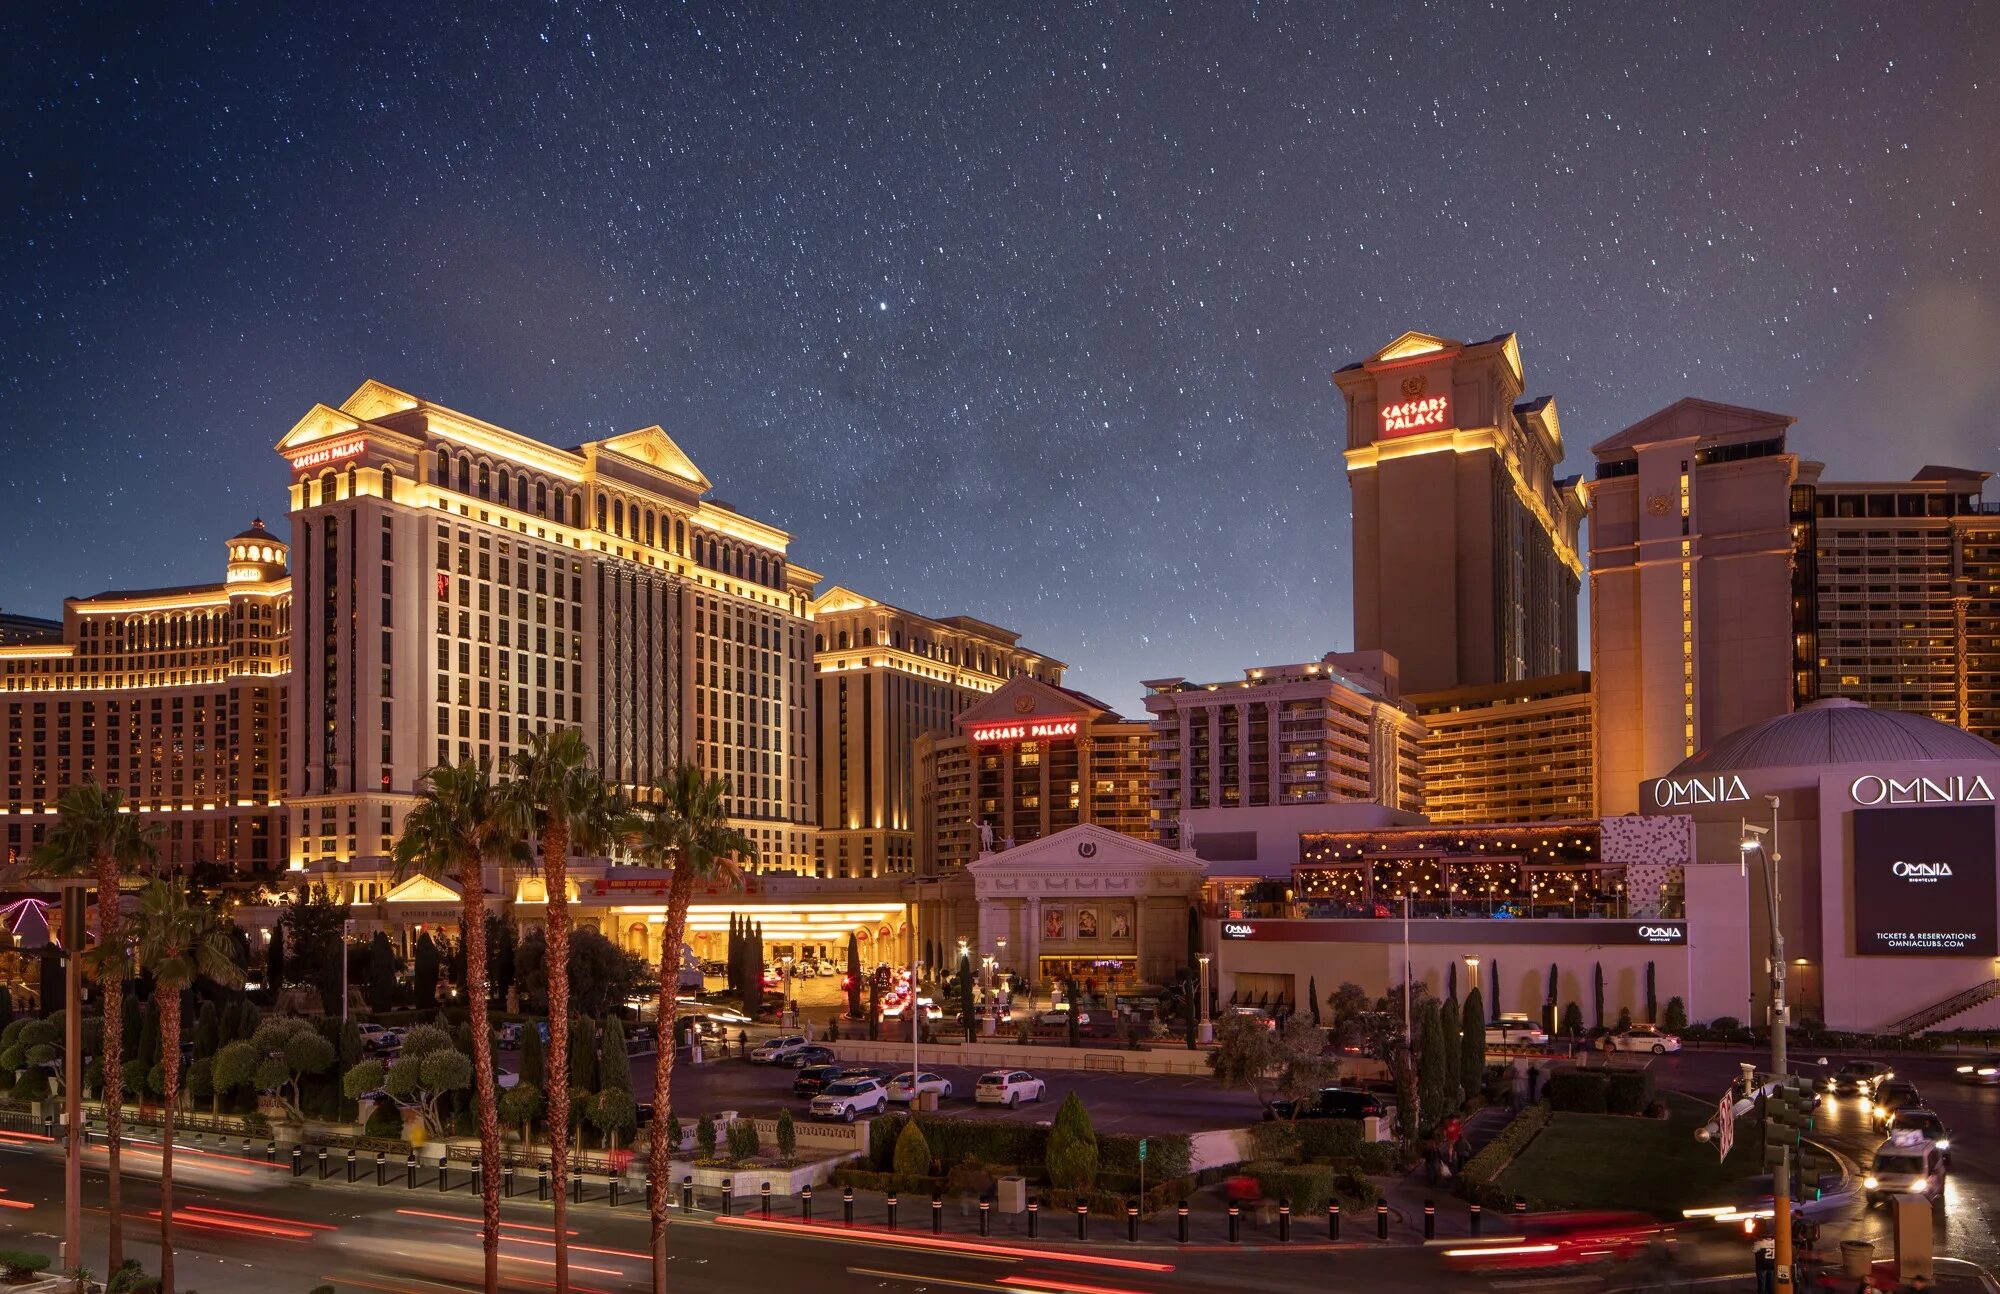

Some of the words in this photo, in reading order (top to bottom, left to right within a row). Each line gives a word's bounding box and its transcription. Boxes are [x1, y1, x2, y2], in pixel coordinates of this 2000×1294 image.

[1381, 396, 1448, 419] CAESARS
[1385, 409, 1444, 431] PALACE
[293, 449, 330, 469] CAESARS
[332, 440, 364, 459] PALACE
[973, 726, 1025, 741] CAESARS
[1031, 722, 1077, 736] PALACE
[1654, 775, 1751, 808] OMNIA
[1851, 775, 1996, 805] OMNIA
[1892, 861, 1953, 877] OMNIA
[1225, 924, 1252, 934] OMNIA
[1638, 926, 1681, 937] OMNIA
[1876, 932, 1907, 940] TICKETS
[1909, 932, 1915, 940] &
[1917, 932, 1977, 940] RESERVATIONS
[1888, 940, 1965, 948] OMNIACLUBS.COM
